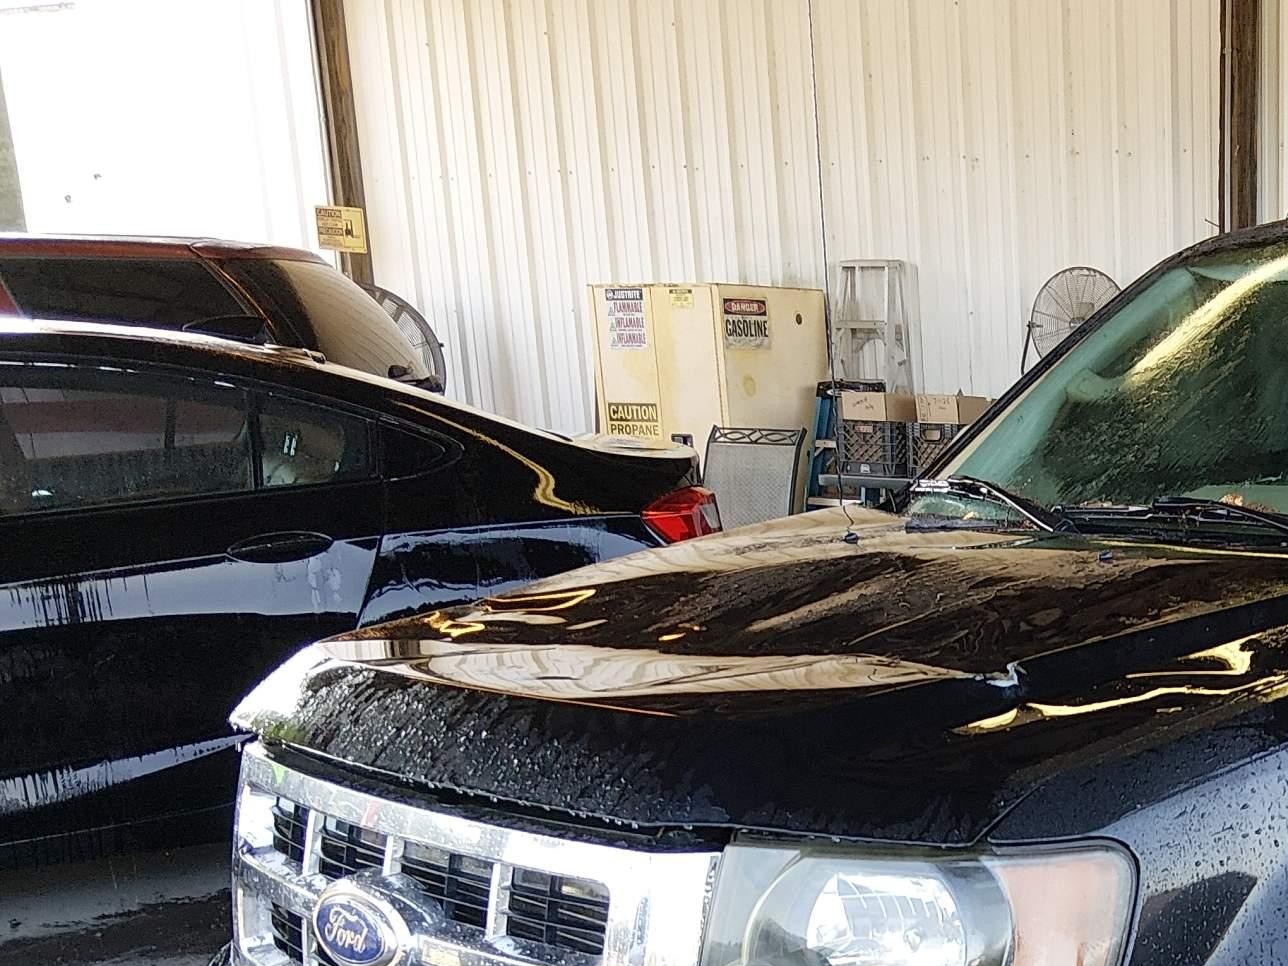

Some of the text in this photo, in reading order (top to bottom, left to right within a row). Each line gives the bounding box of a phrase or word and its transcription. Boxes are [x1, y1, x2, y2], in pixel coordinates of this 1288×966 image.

[614, 290, 641, 299] JUSTRITE
[613, 302, 643, 313] FLAMMABLE
[731, 302, 759, 312] DANGER
[615, 317, 645, 329] INFLAMABLE
[725, 319, 768, 337] GASOLINE
[617, 333, 647, 345] INFLAMMABLE
[609, 405, 657, 420] CAUTION
[610, 423, 660, 436] PROPANE
[325, 907, 368, 954] Ford
